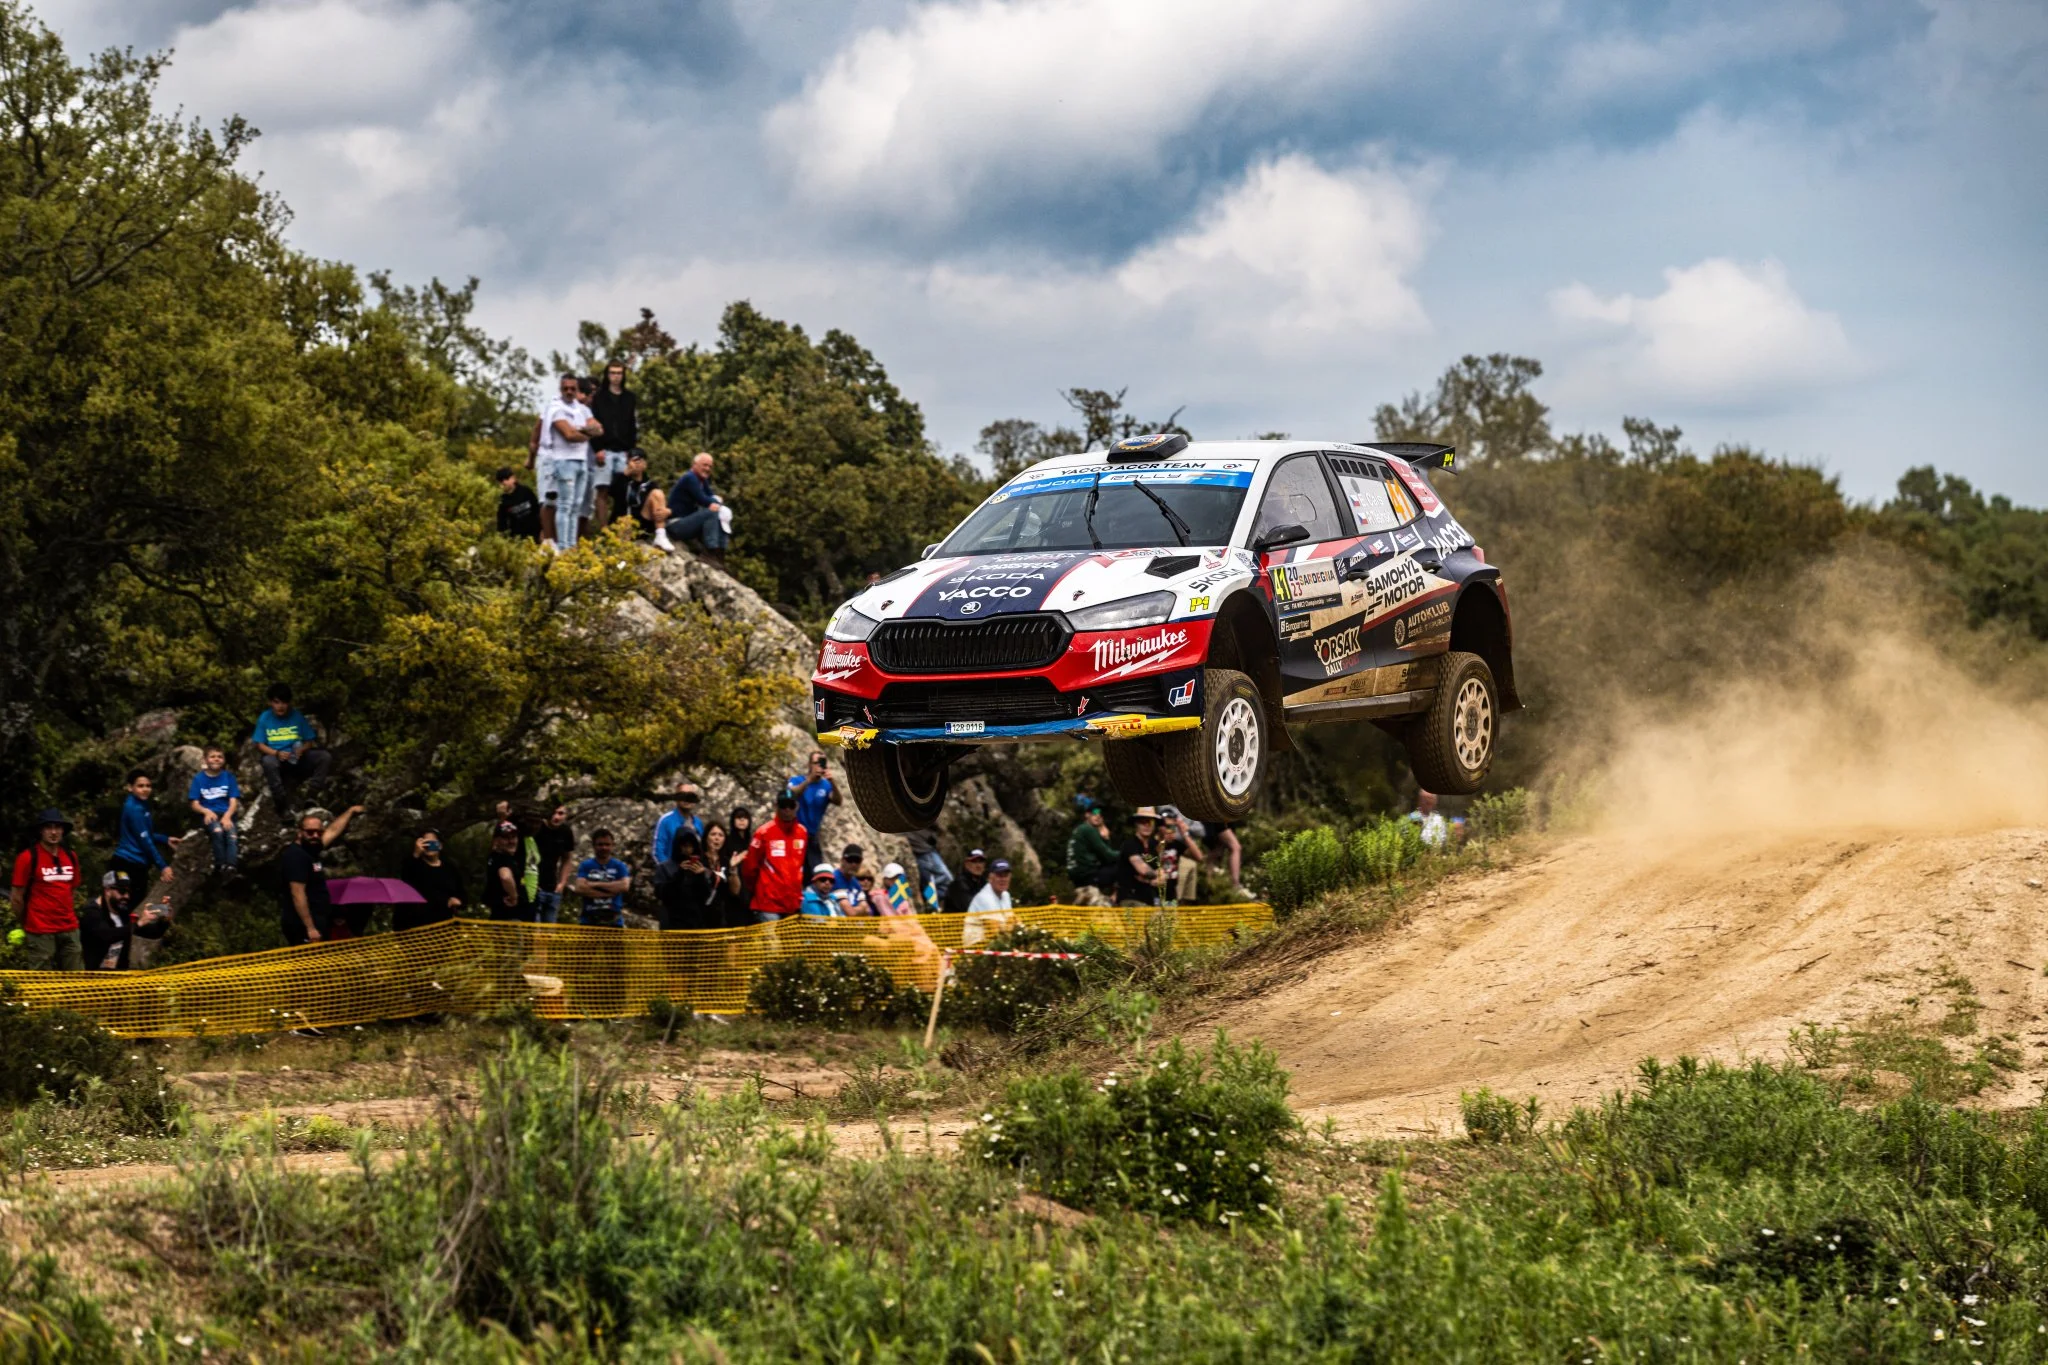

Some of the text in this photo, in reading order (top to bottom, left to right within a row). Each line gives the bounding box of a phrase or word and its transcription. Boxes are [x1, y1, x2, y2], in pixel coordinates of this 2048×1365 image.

[1009, 473, 1182, 494] BEYOND RALLY
[1061, 466, 1113, 476] YACCO
[1117, 463, 1158, 471] ACCR
[1386, 477, 1416, 522] 41
[1428, 519, 1471, 561] YACCO
[1274, 566, 1291, 600] 41
[1287, 566, 1336, 586] 20 SARDEGNA
[1291, 581, 1303, 597] 23
[1366, 558, 1420, 597] SAMOHÝL
[938, 586, 1033, 602] YACCO
[1384, 575, 1426, 608] MOTOR
[1407, 601, 1450, 629] AUTOKLUB
[820, 641, 861, 671] Milwaukee
[1087, 628, 1188, 672] Milwaukee
[952, 722, 983, 733] 12R 0116
[41, 865, 74, 876] WC
